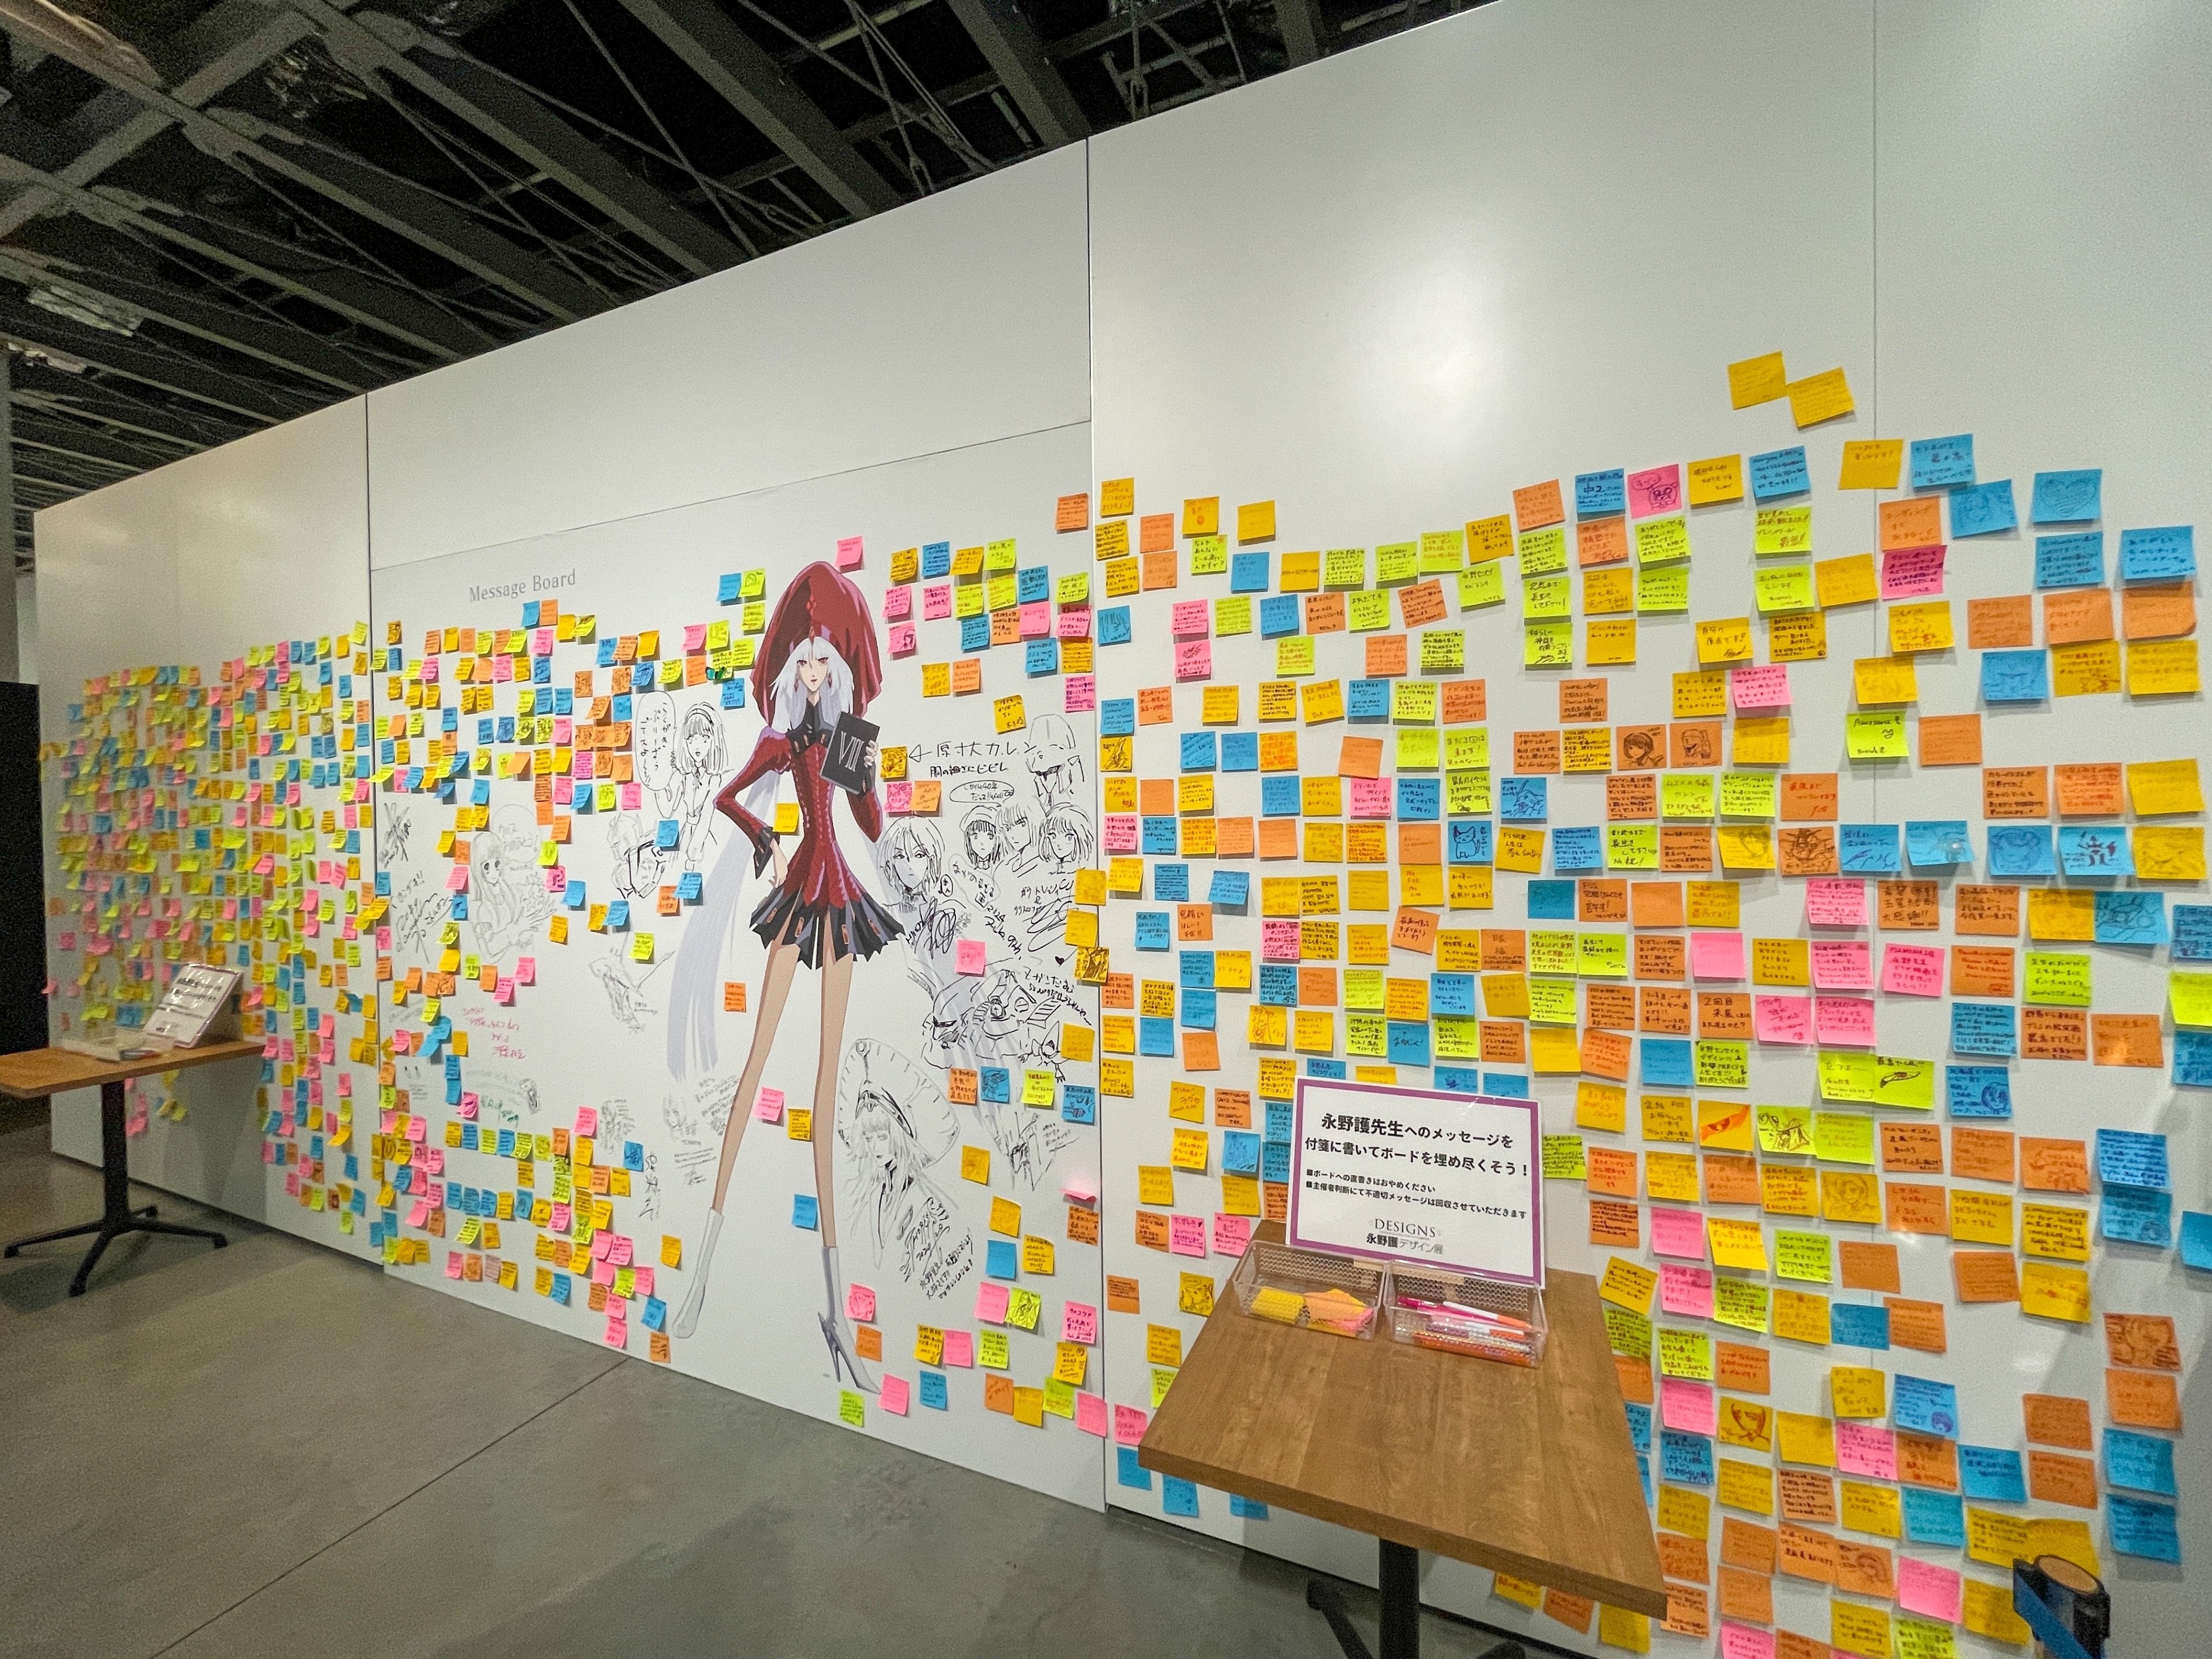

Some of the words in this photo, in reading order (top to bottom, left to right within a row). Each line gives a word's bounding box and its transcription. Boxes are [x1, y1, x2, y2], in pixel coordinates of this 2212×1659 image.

[470, 582, 526, 602] Message
[533, 568, 576, 591] Board
[1704, 998, 1733, 1006] 2回目
[1321, 1113, 1513, 1148] 永野護先生へのメッセージを
[1375, 1218, 1436, 1238] DESIGNS
[1366, 1233, 1443, 1255] 永野護デザイン展
